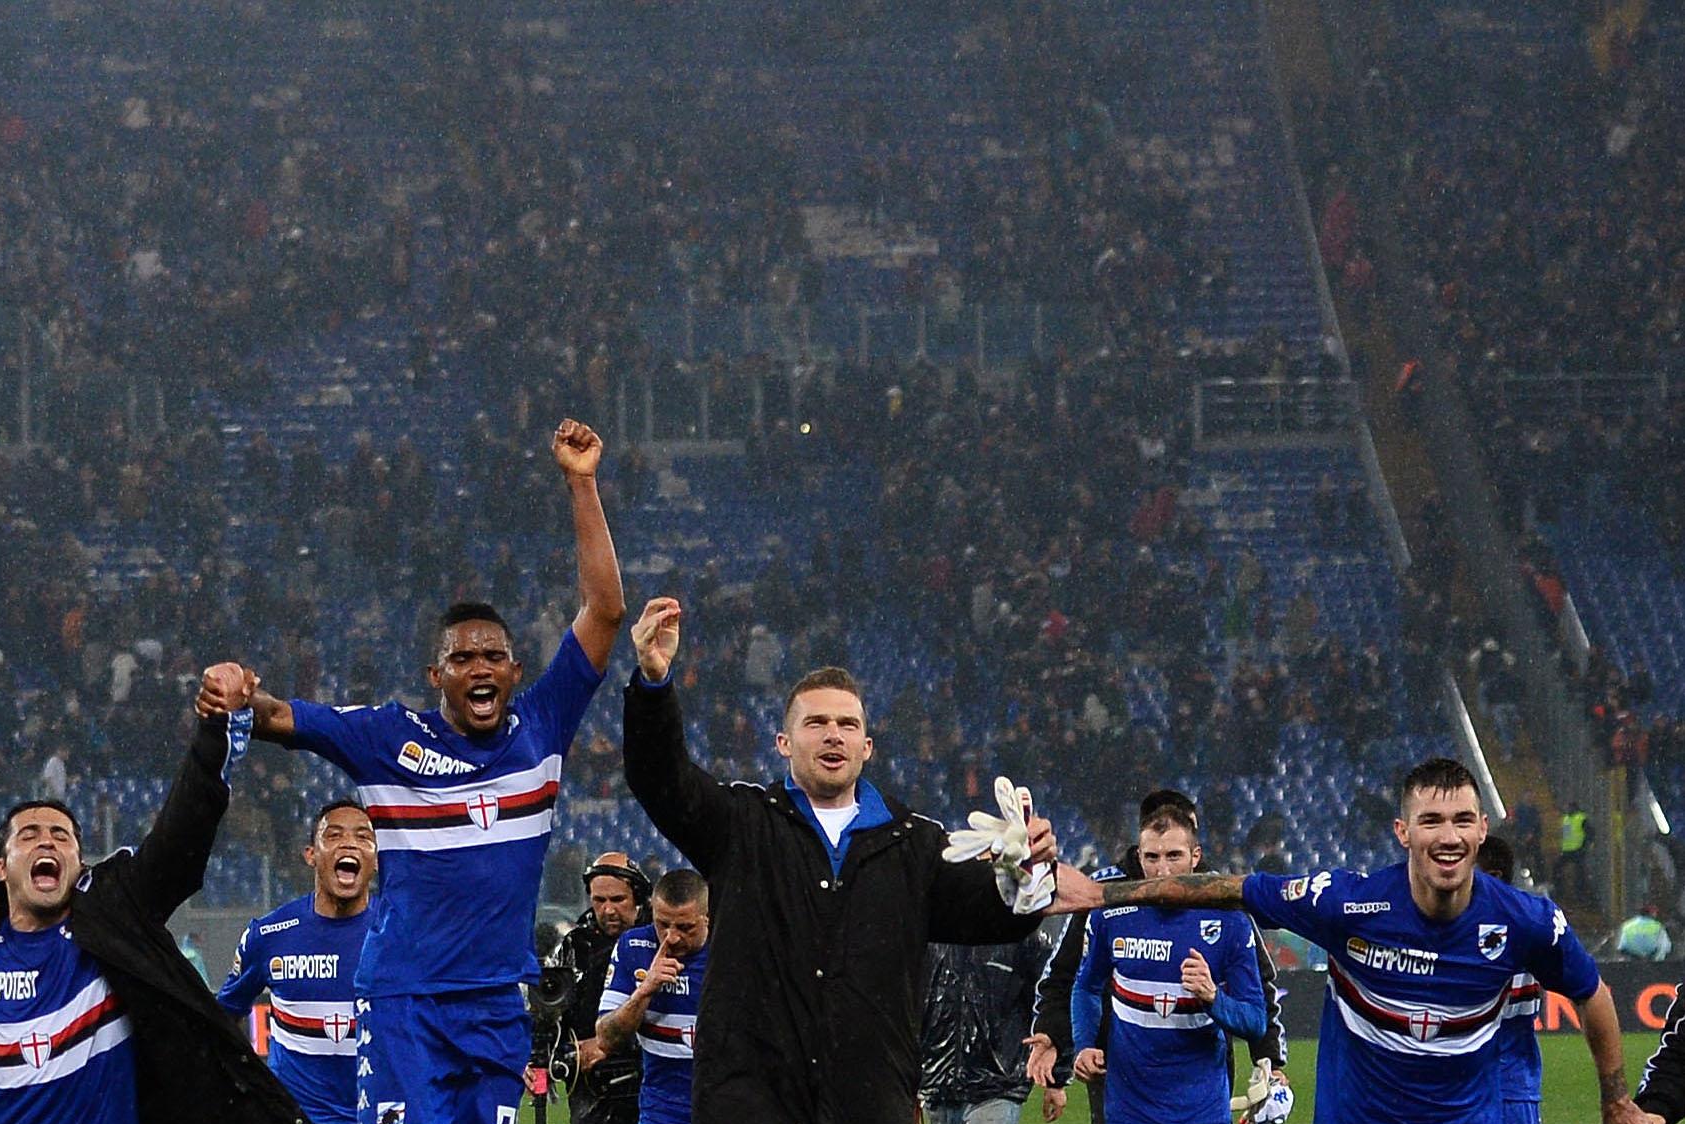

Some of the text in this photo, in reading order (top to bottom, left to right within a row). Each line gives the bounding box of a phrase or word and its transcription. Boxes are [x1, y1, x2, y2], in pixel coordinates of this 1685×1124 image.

[1343, 901, 1391, 914] Kappa
[1124, 937, 1173, 962] TEMPOTEST
[1367, 942, 1439, 976] TEMPOTEST
[282, 954, 340, 980] TEMPOTEST
